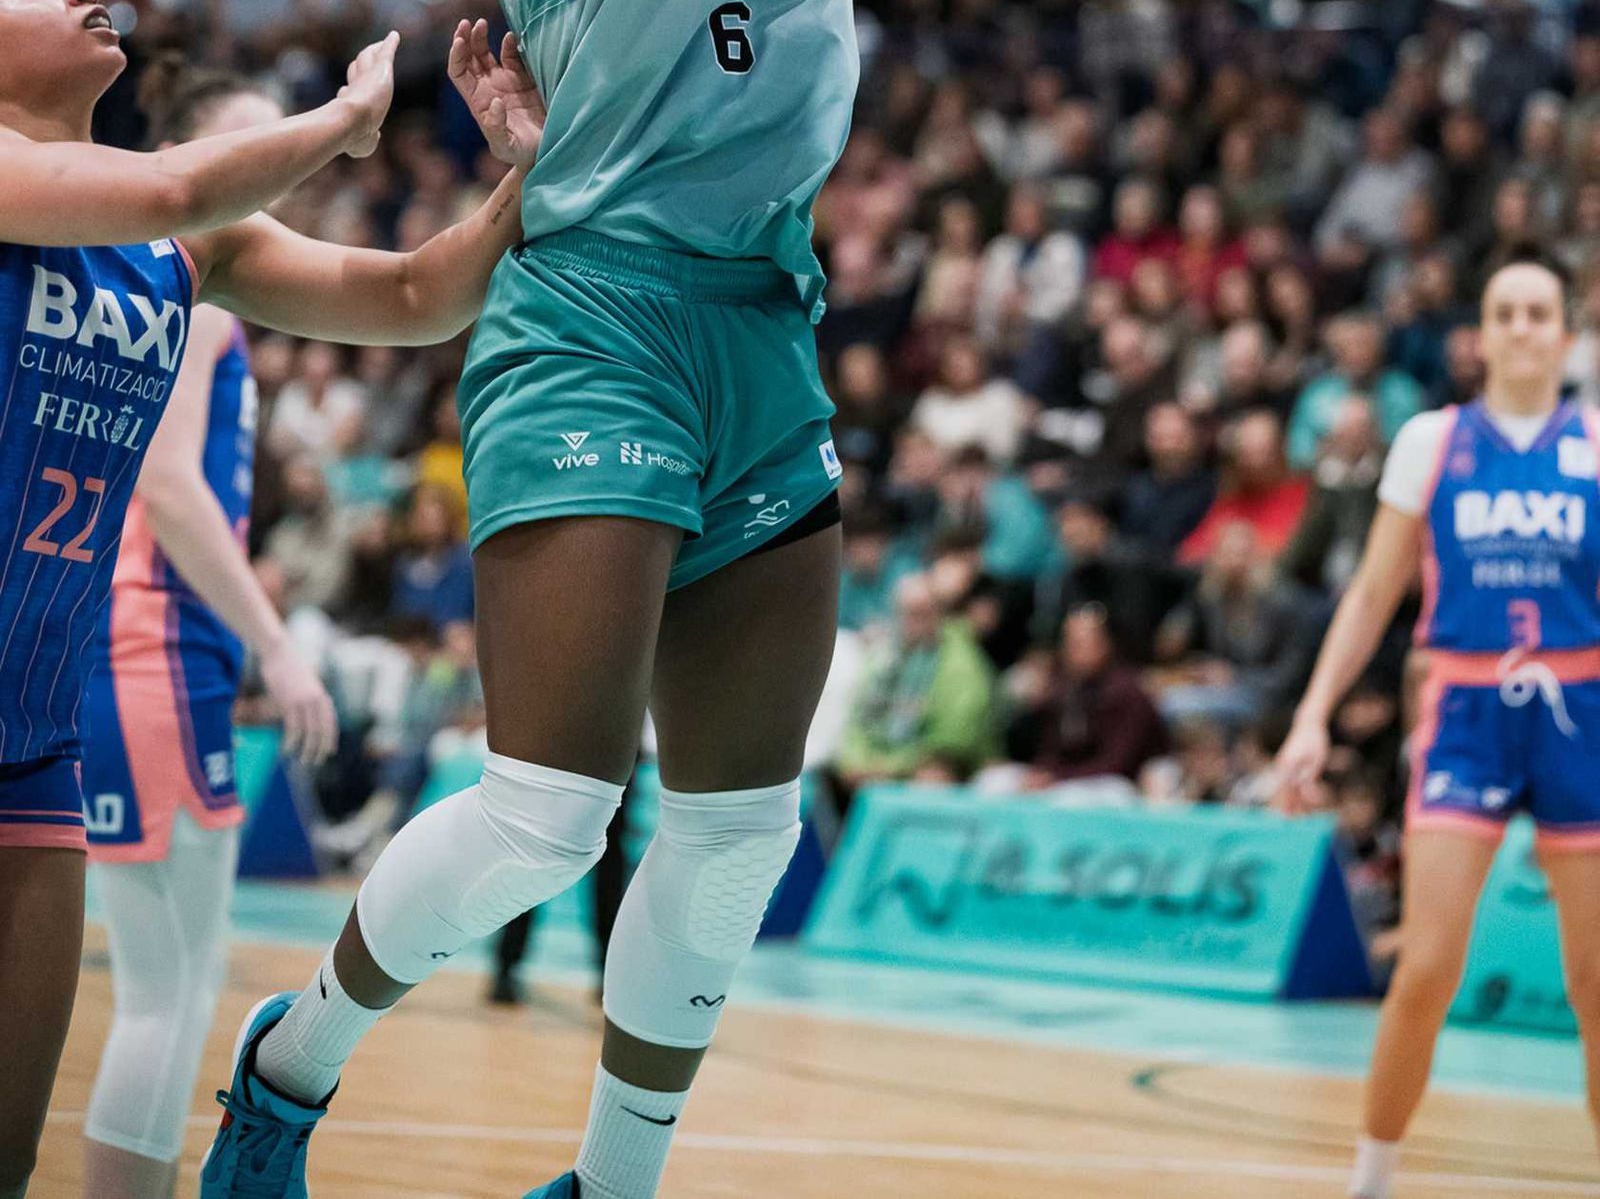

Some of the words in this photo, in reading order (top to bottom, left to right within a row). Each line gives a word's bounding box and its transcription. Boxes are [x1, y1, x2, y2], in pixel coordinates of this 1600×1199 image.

[708, 0, 756, 75] 6
[552, 452, 600, 471] vive
[22, 466, 106, 563] 22
